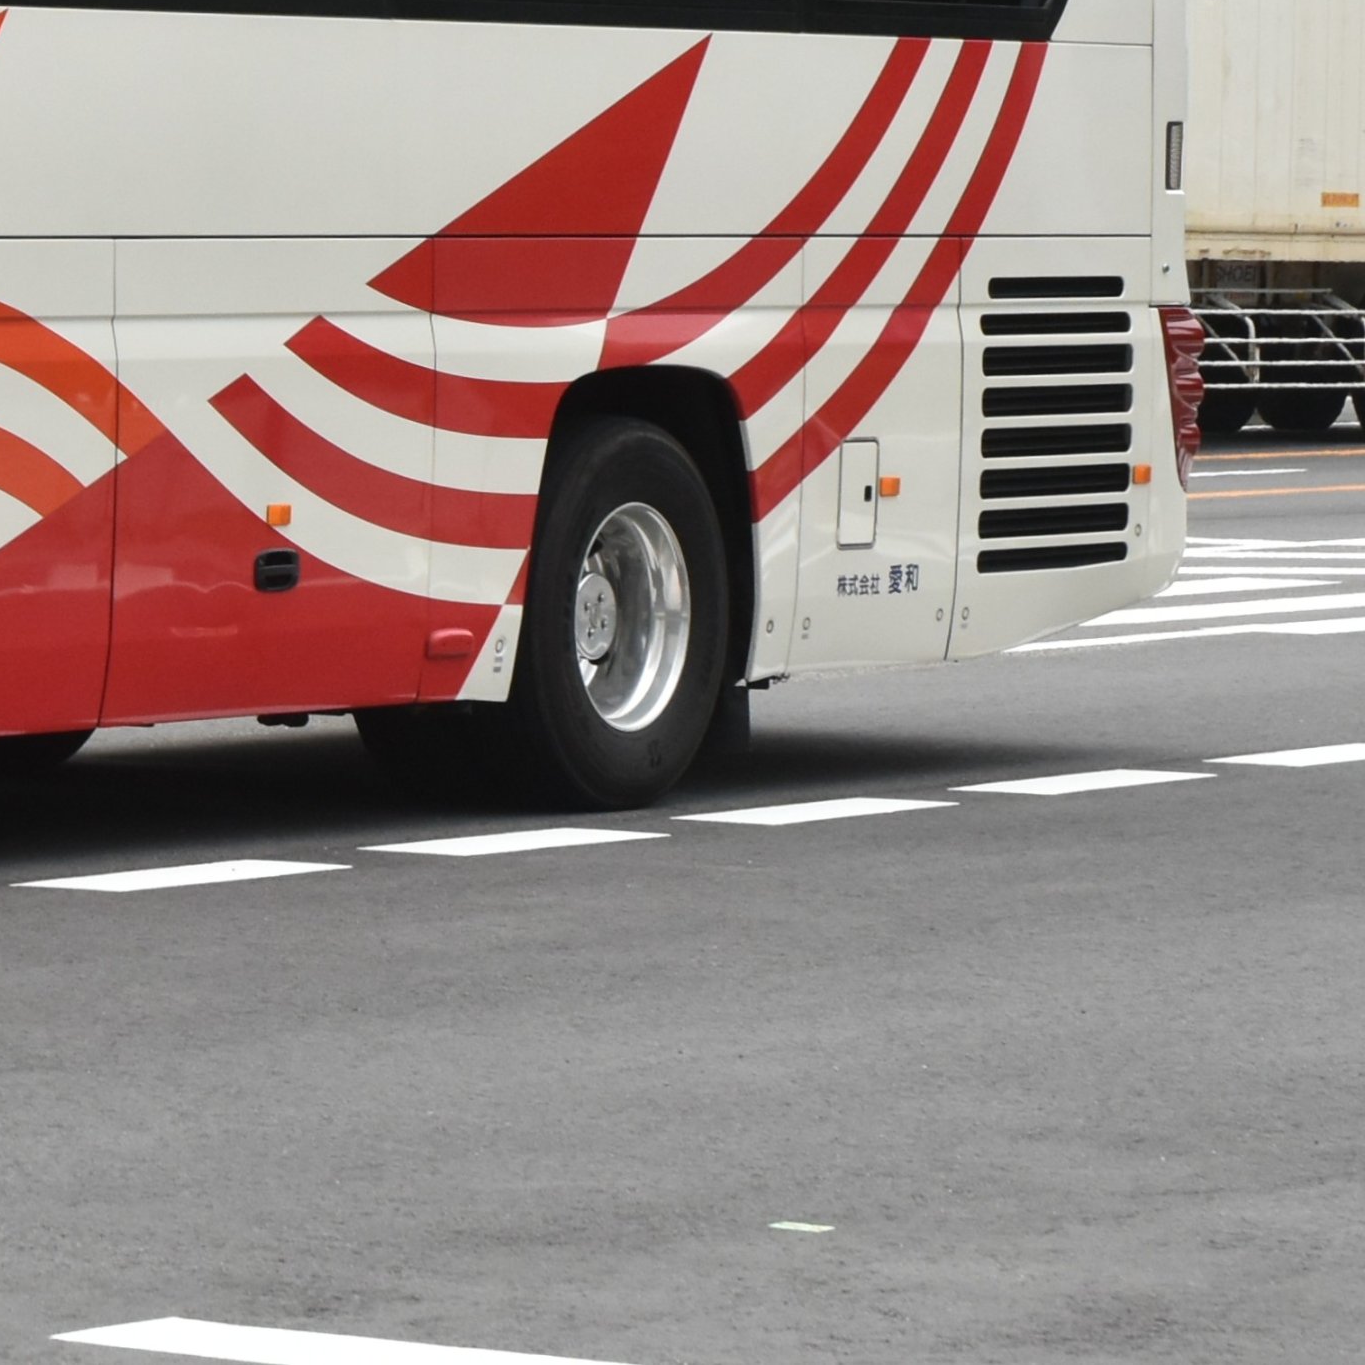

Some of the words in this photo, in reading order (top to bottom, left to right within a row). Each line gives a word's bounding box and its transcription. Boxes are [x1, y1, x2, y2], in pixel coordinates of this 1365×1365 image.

[836, 573, 881, 596] 株式会社
[888, 562, 920, 594] 愛和
